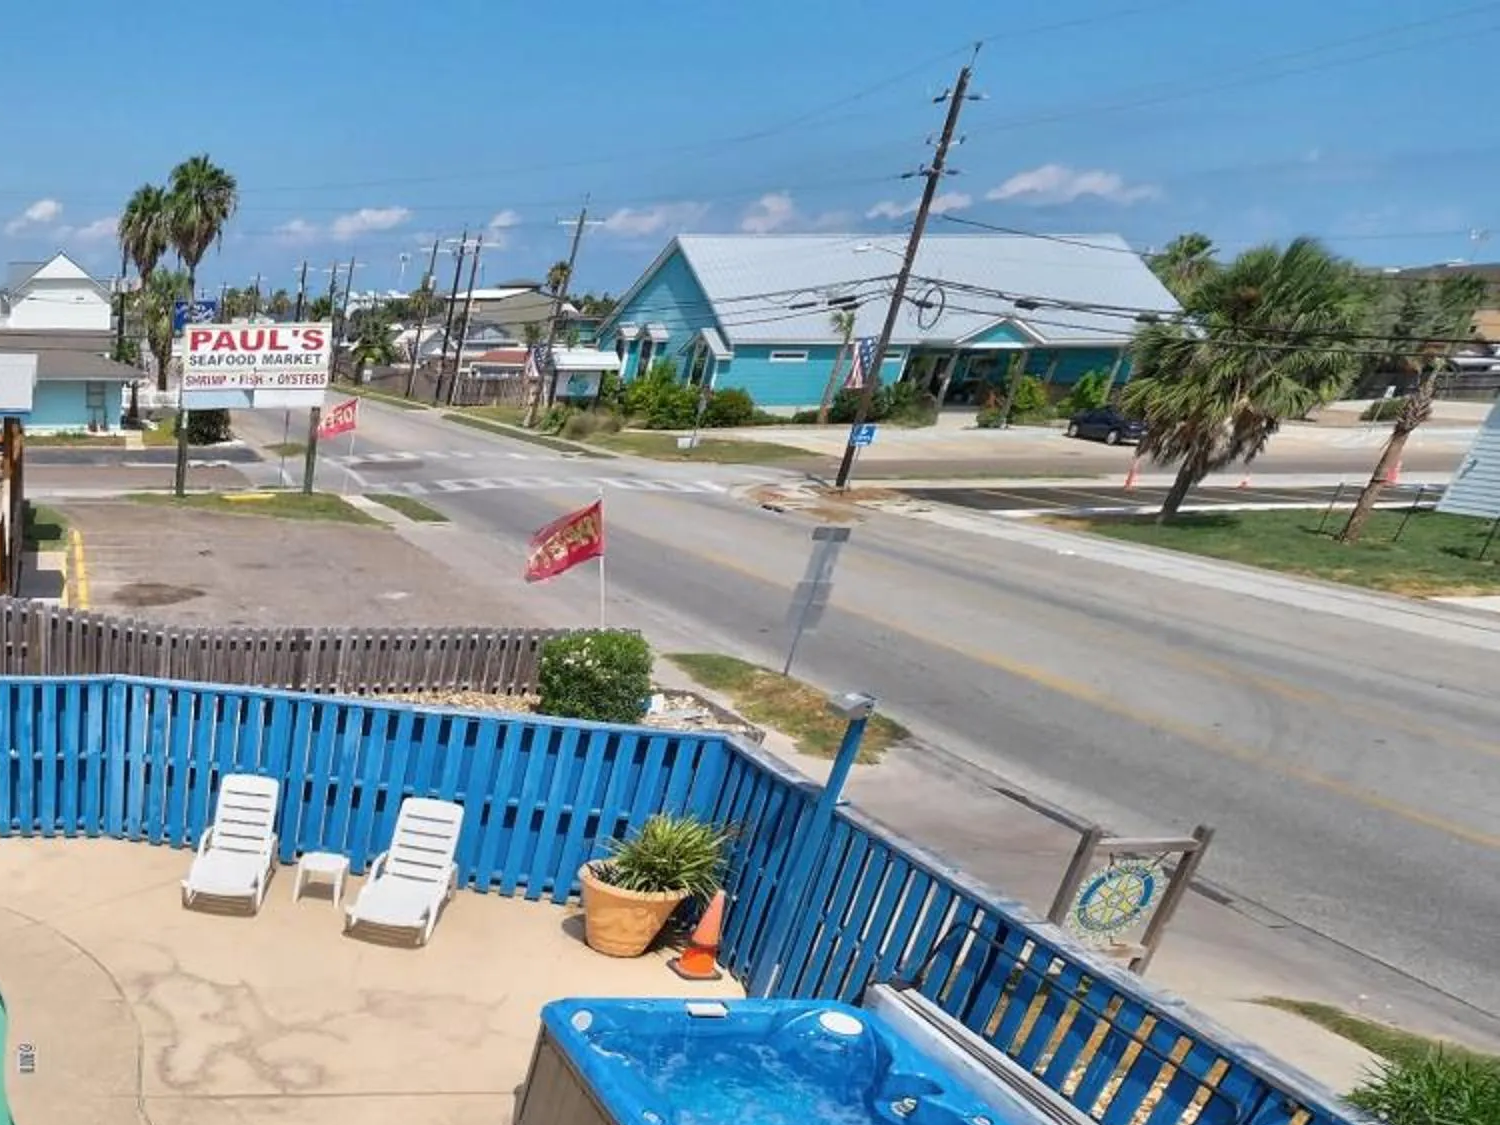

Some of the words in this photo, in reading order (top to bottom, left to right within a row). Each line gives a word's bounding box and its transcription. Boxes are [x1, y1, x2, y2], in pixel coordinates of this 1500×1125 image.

[189, 329, 325, 351] PAUL'S
[189, 353, 257, 366] SEAFOOD
[261, 353, 323, 365] MARKET
[185, 375, 227, 387] SHRIMP
[239, 374, 264, 386] FISH
[277, 373, 326, 385] OYSTERS
